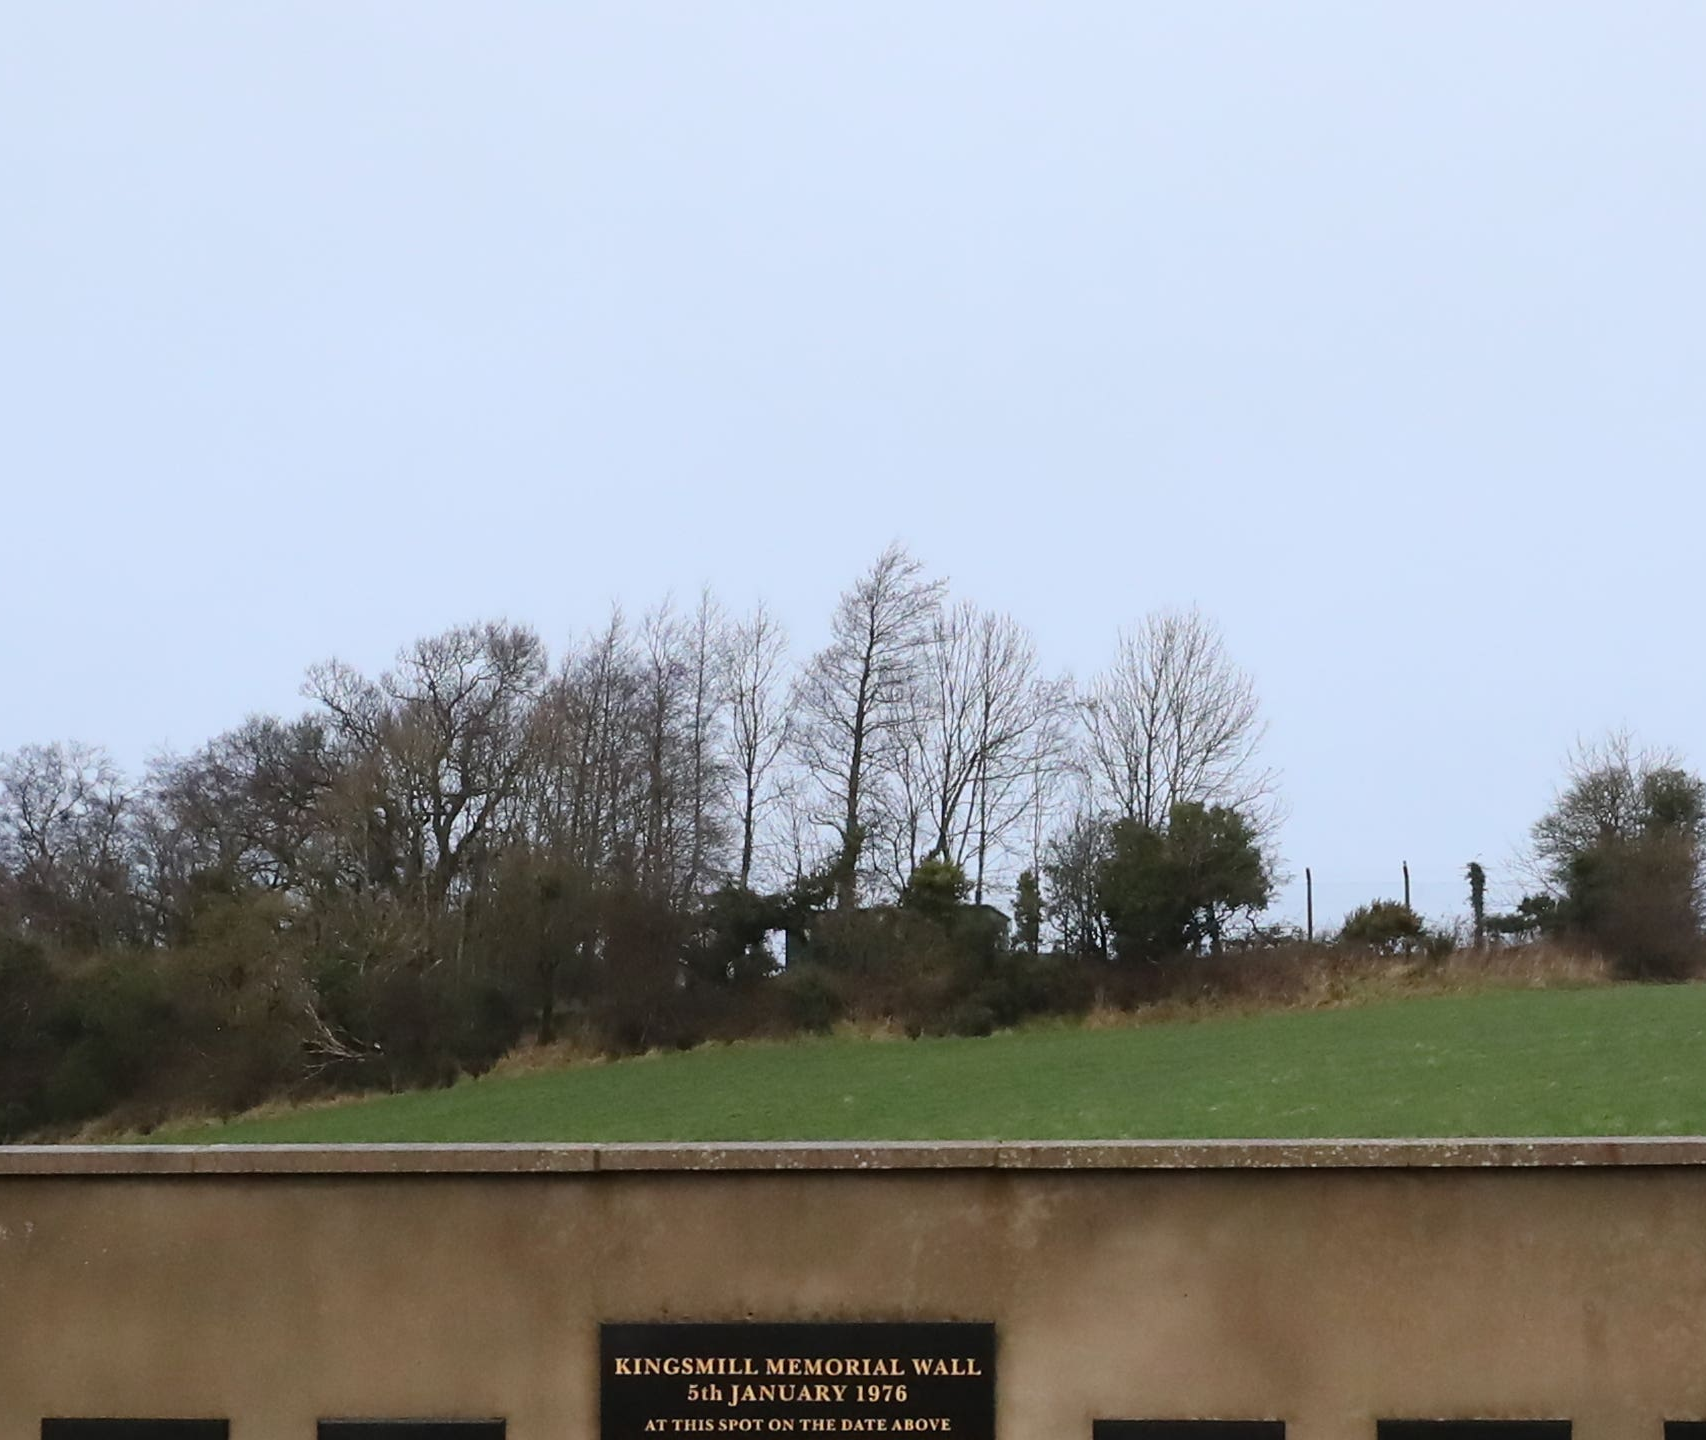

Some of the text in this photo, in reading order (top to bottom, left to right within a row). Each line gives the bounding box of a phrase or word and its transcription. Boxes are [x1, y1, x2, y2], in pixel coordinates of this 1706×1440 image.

[615, 1357, 981, 1376] KINGSMILL MEMORIAL WALL
[688, 1384, 907, 1407] 5th JANUARY 1976
[645, 1418, 951, 1431] AT THIS SPOT ON THE DATE ABOVE
